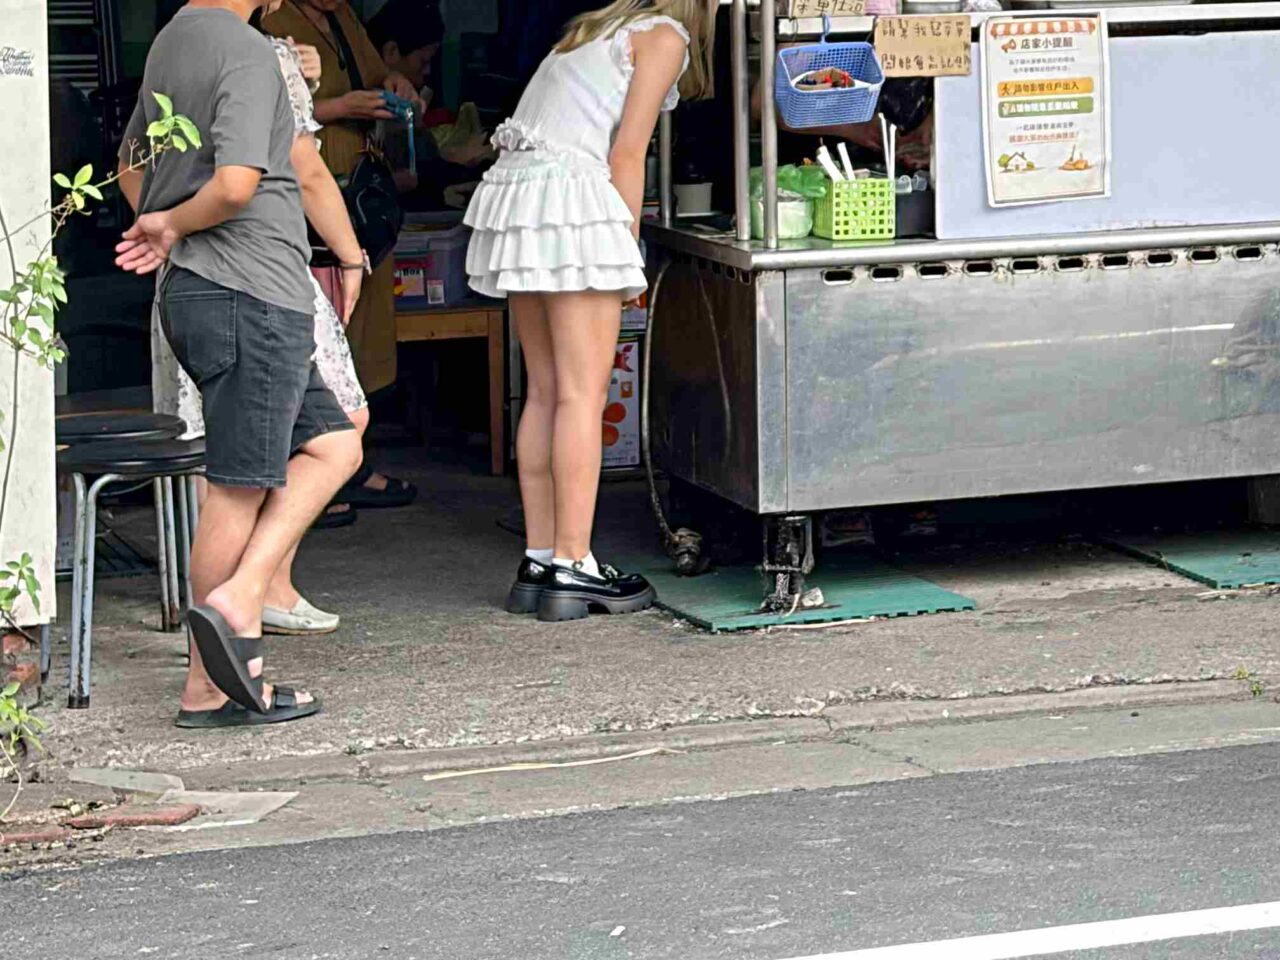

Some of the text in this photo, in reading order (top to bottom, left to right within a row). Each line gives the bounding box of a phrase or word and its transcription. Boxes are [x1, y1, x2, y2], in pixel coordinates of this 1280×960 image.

[1020, 37, 1073, 49] 店家小提醒
